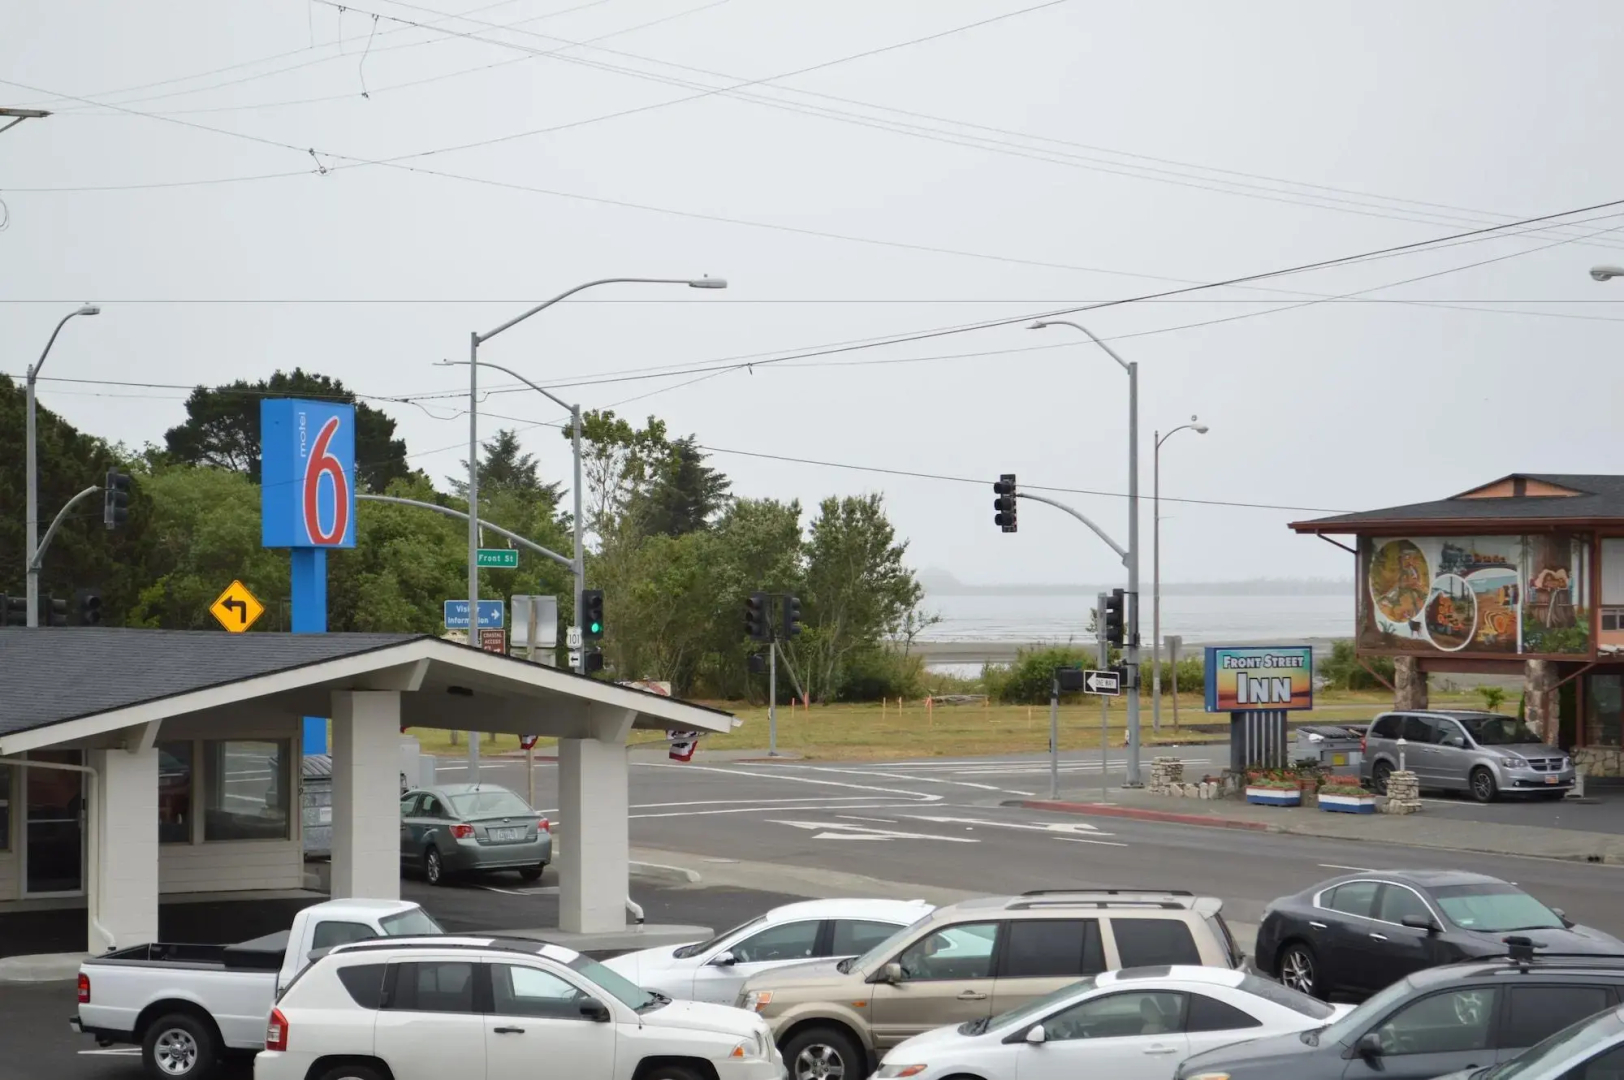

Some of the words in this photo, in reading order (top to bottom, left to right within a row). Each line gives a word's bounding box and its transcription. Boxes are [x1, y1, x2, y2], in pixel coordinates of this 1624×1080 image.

[298, 411, 306, 458] motel
[302, 415, 349, 545] 6
[478, 554, 501, 562] Front
[504, 554, 514, 562] St
[456, 604, 481, 613] Visir
[568, 634, 580, 645] 101
[1223, 655, 1261, 669] FRONT
[1263, 654, 1305, 668] STREET
[1236, 672, 1291, 704] INN
